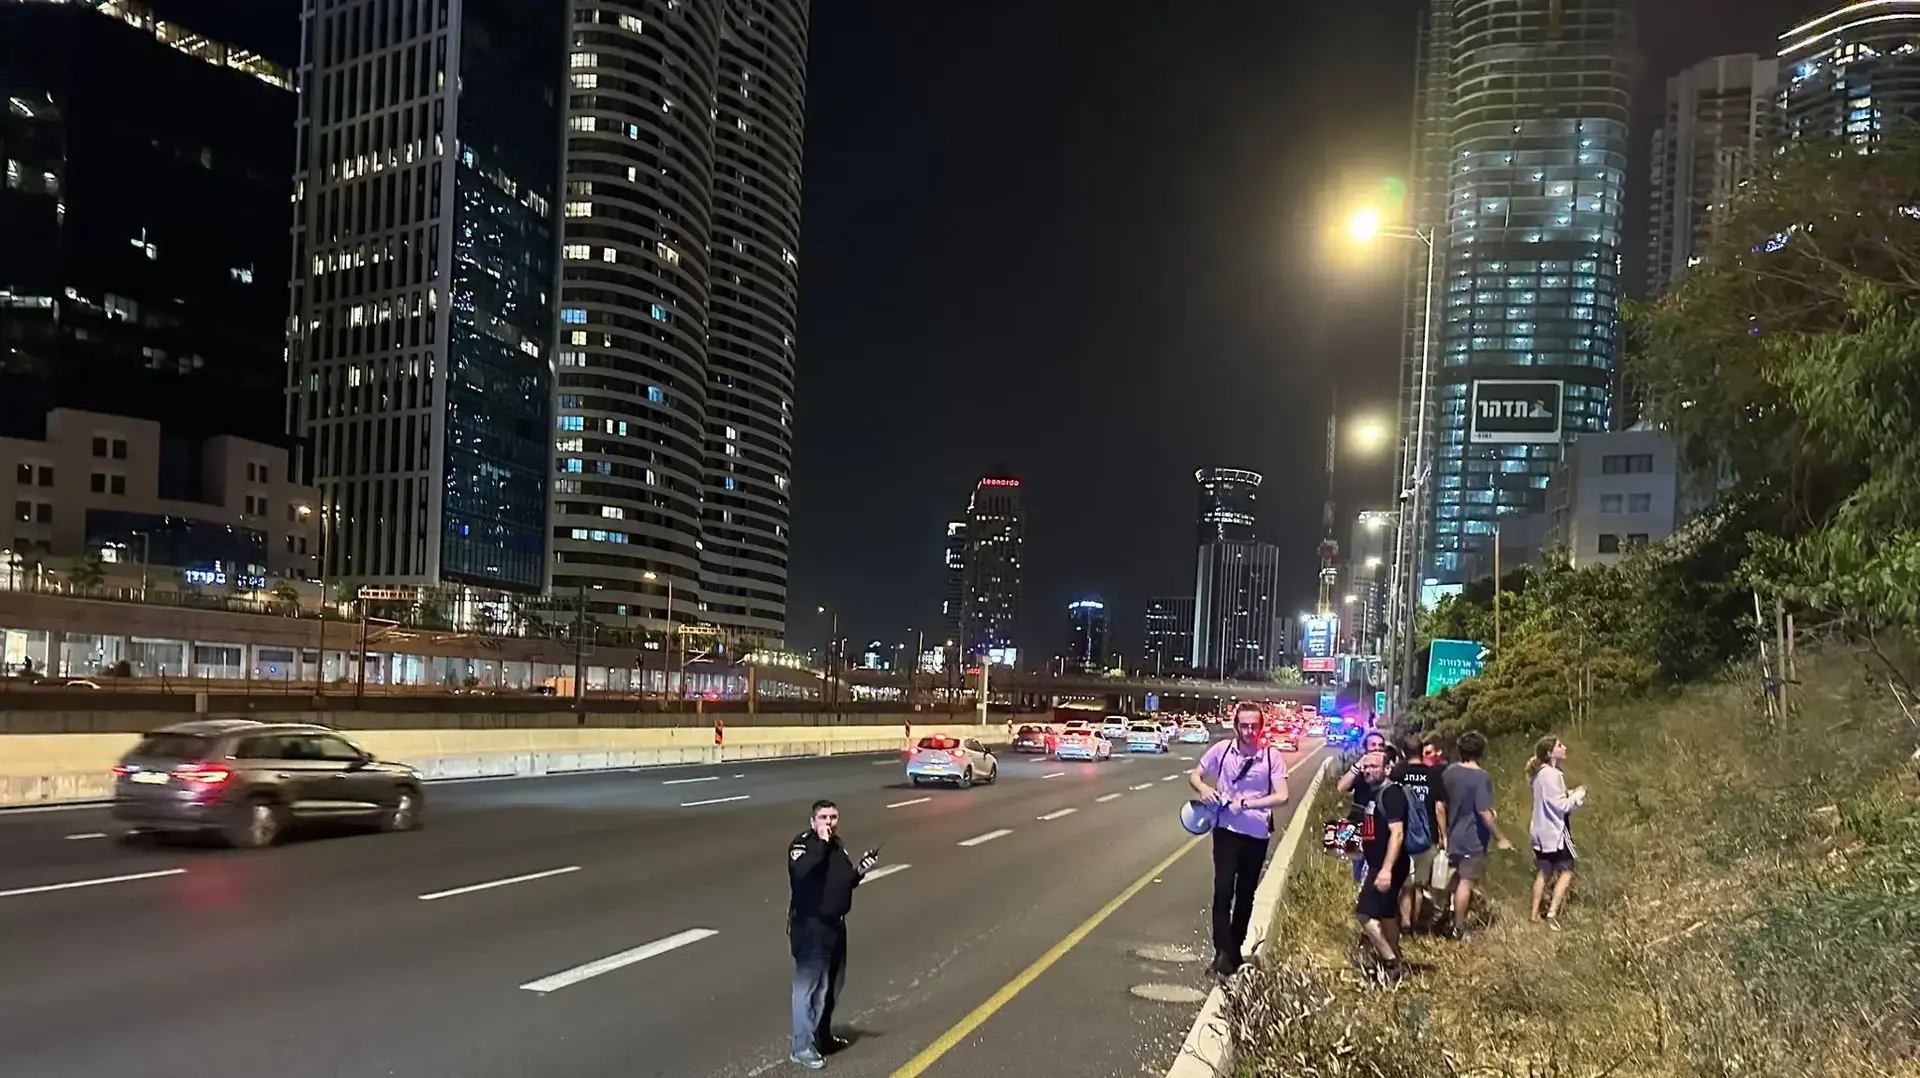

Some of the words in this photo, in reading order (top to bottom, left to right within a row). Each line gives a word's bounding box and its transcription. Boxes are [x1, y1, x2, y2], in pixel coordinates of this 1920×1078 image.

[1478, 400, 1528, 418] תדהר
[982, 477, 1019, 486] Leonardo
[1448, 667, 1456, 675] גן
